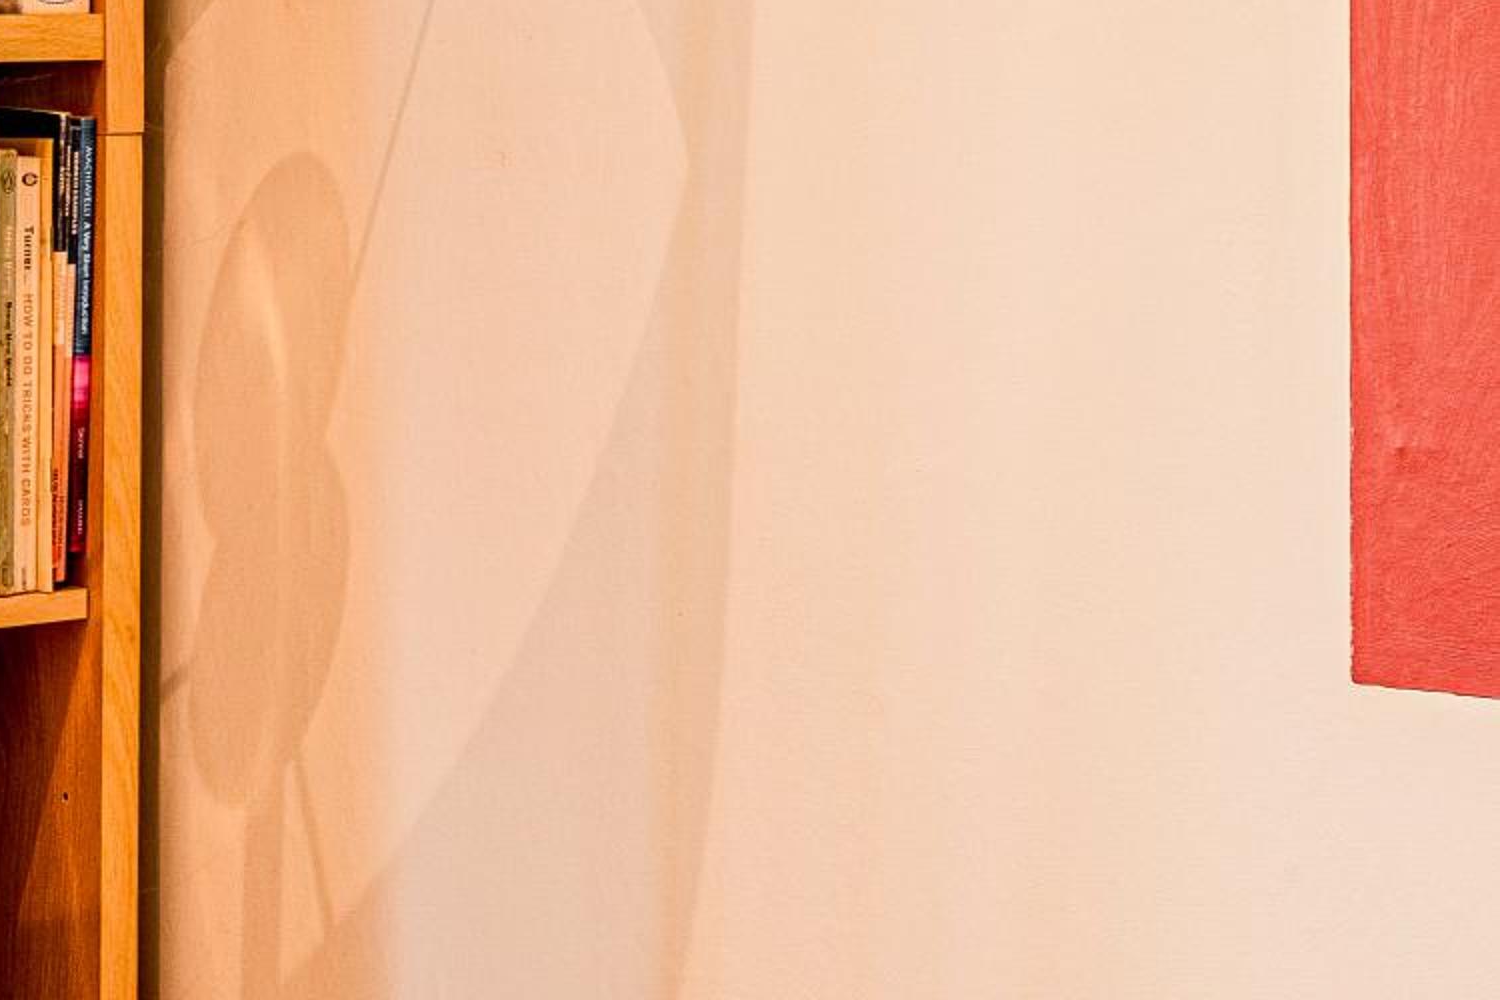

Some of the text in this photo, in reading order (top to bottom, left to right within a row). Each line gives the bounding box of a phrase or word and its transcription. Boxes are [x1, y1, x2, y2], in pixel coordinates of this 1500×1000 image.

[83, 145, 94, 217] MACHIAVELLI
[23, 225, 35, 271] Turner
[81, 221, 92, 335] A Very Short Introduction
[22, 293, 33, 327] HOW
[22, 331, 33, 351] TO
[22, 381, 33, 432] TRICKS
[21, 436, 32, 473] WITH
[21, 478, 32, 526] CARDS
